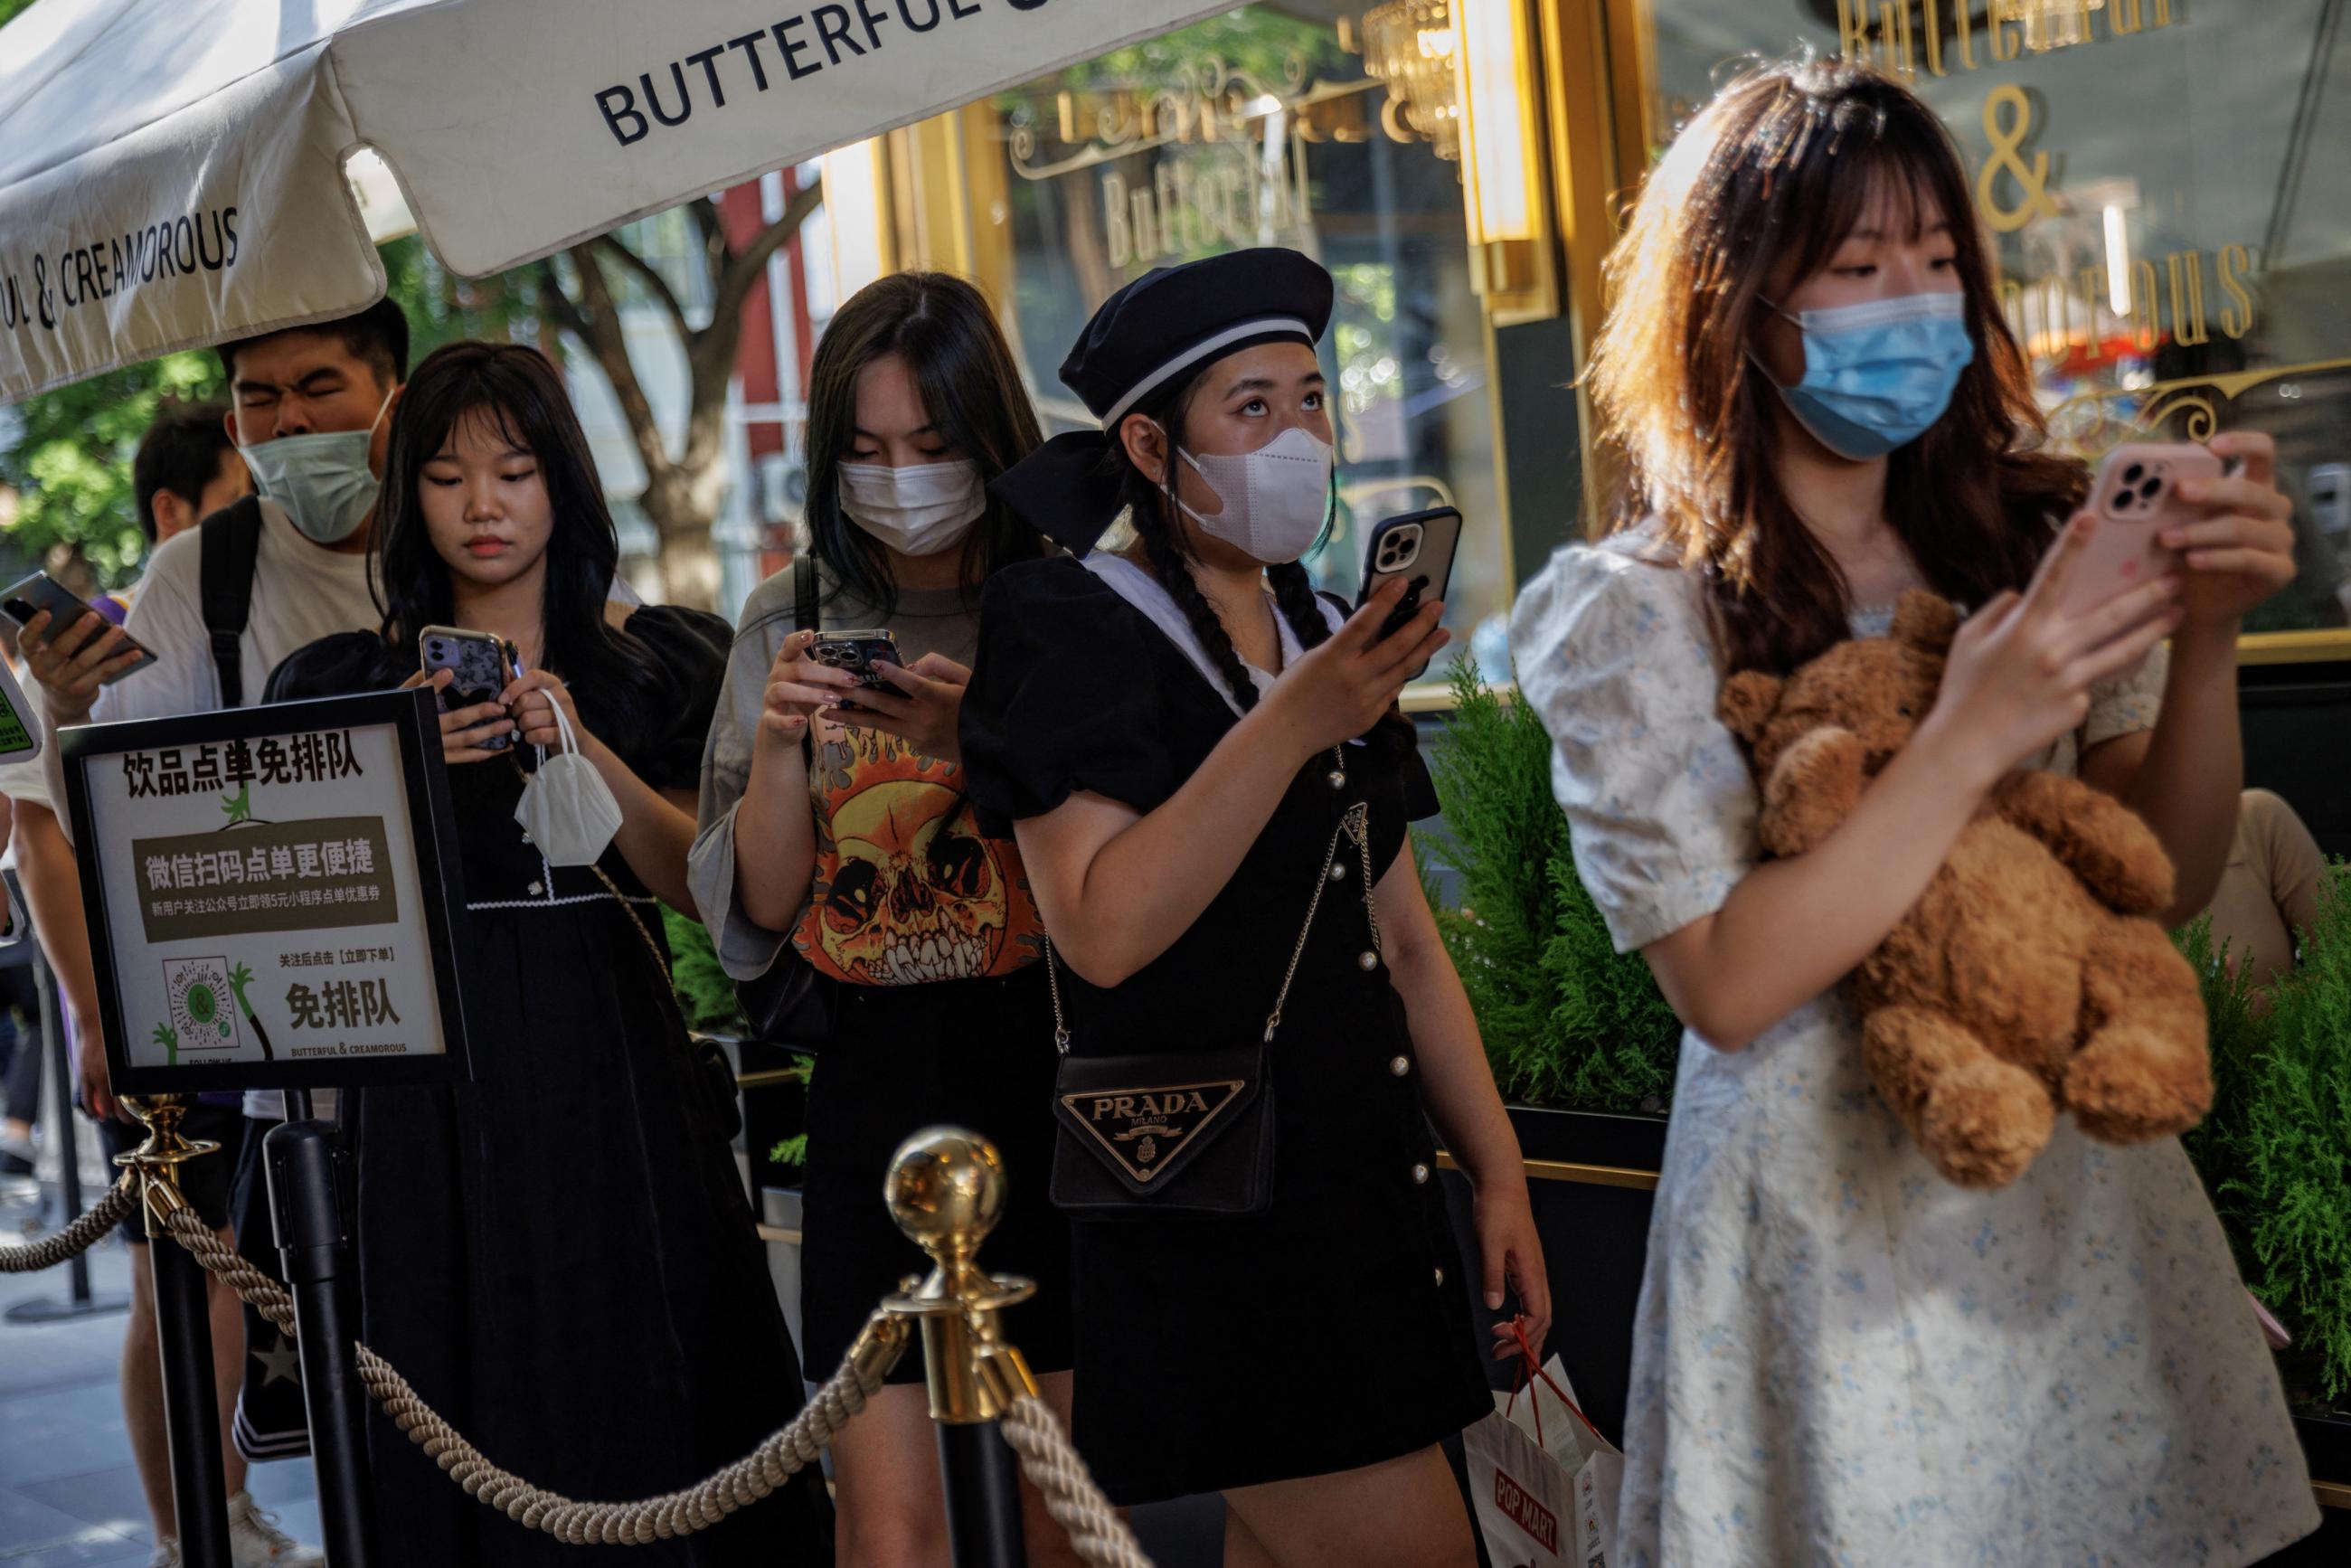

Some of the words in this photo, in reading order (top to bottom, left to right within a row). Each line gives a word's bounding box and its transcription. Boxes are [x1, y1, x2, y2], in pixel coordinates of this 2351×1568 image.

[1977, 84, 2060, 232] &
[34, 253, 58, 330] &
[61, 207, 238, 307] CREAMOROUS
[123, 730, 364, 798] 饮品点单免排队
[145, 837, 375, 891] 微信扫码点单更便捷
[151, 883, 381, 918] 新用户关注公众号立即领5元小程序点单优惠券
[279, 947, 395, 968] 关注后点击【立即下单】
[194, 992, 210, 1015] &
[285, 978, 401, 1030] 免排队
[291, 1046, 338, 1057] BUTTERFUL
[339, 1042, 347, 1055] &
[349, 1043, 407, 1054] CREAMOROUS
[1092, 1091, 1208, 1120] PRADA
[1131, 1115, 1167, 1126] MILANO
[1497, 1476, 1520, 1515] POP
[1522, 1499, 1554, 1546] MART
